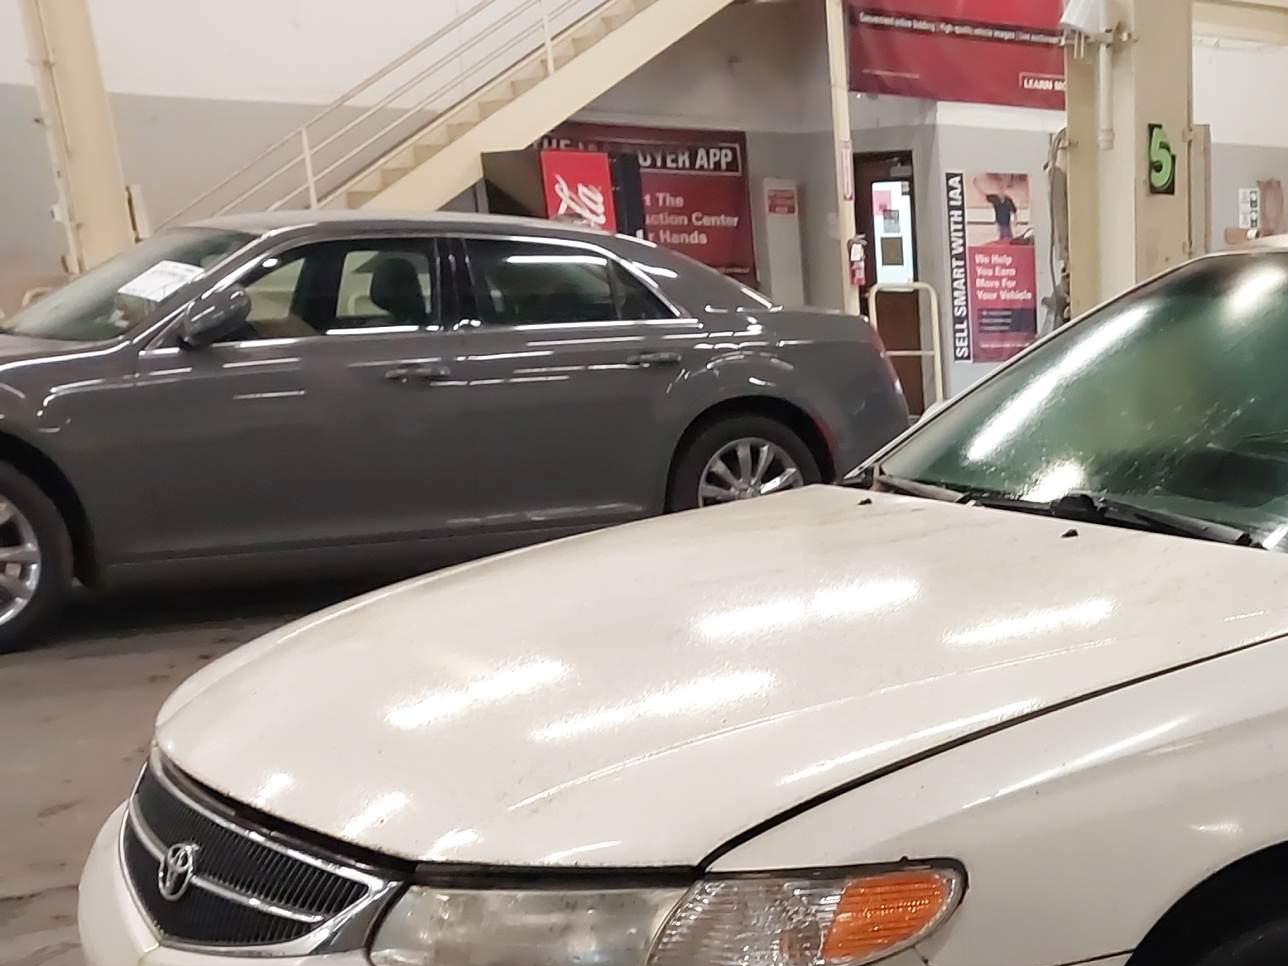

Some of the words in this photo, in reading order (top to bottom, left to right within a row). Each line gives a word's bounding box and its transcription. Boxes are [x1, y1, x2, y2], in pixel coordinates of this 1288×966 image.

[1024, 78, 1053, 91] LEARN
[695, 147, 733, 170] APP
[1149, 125, 1174, 190] 5
[948, 175, 962, 206] IAA
[656, 192, 685, 208] The
[691, 212, 739, 228] Center
[659, 229, 708, 245] Hands
[949, 212, 965, 251] WITH
[975, 253, 990, 264] We
[991, 253, 1013, 266] Help
[976, 266, 994, 276] You
[995, 266, 1016, 276] Earn
[951, 257, 967, 318] SMART
[976, 278, 1000, 288] More
[1001, 278, 1017, 288] For
[976, 290, 998, 300] Your
[1000, 289, 1032, 300] Vehicle
[954, 319, 969, 359] SELL
